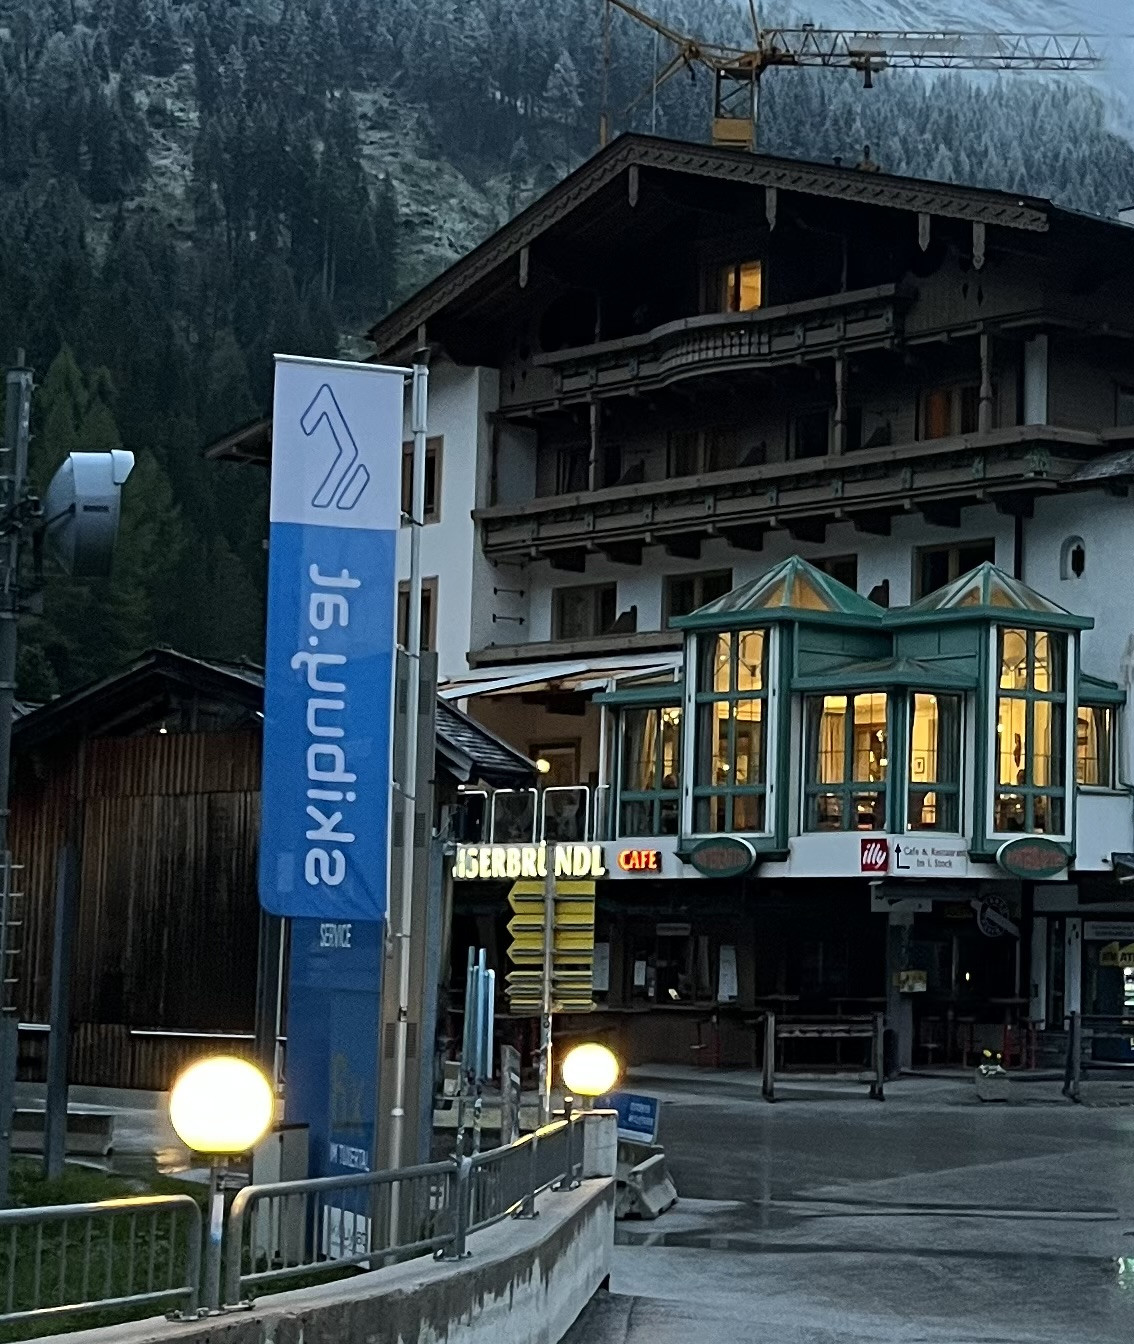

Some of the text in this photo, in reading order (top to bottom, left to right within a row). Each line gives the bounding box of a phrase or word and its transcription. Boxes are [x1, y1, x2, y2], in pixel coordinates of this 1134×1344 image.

[618, 848, 658, 870] CAFE
[862, 842, 887, 870] illy
[320, 923, 352, 948] SERVICE
